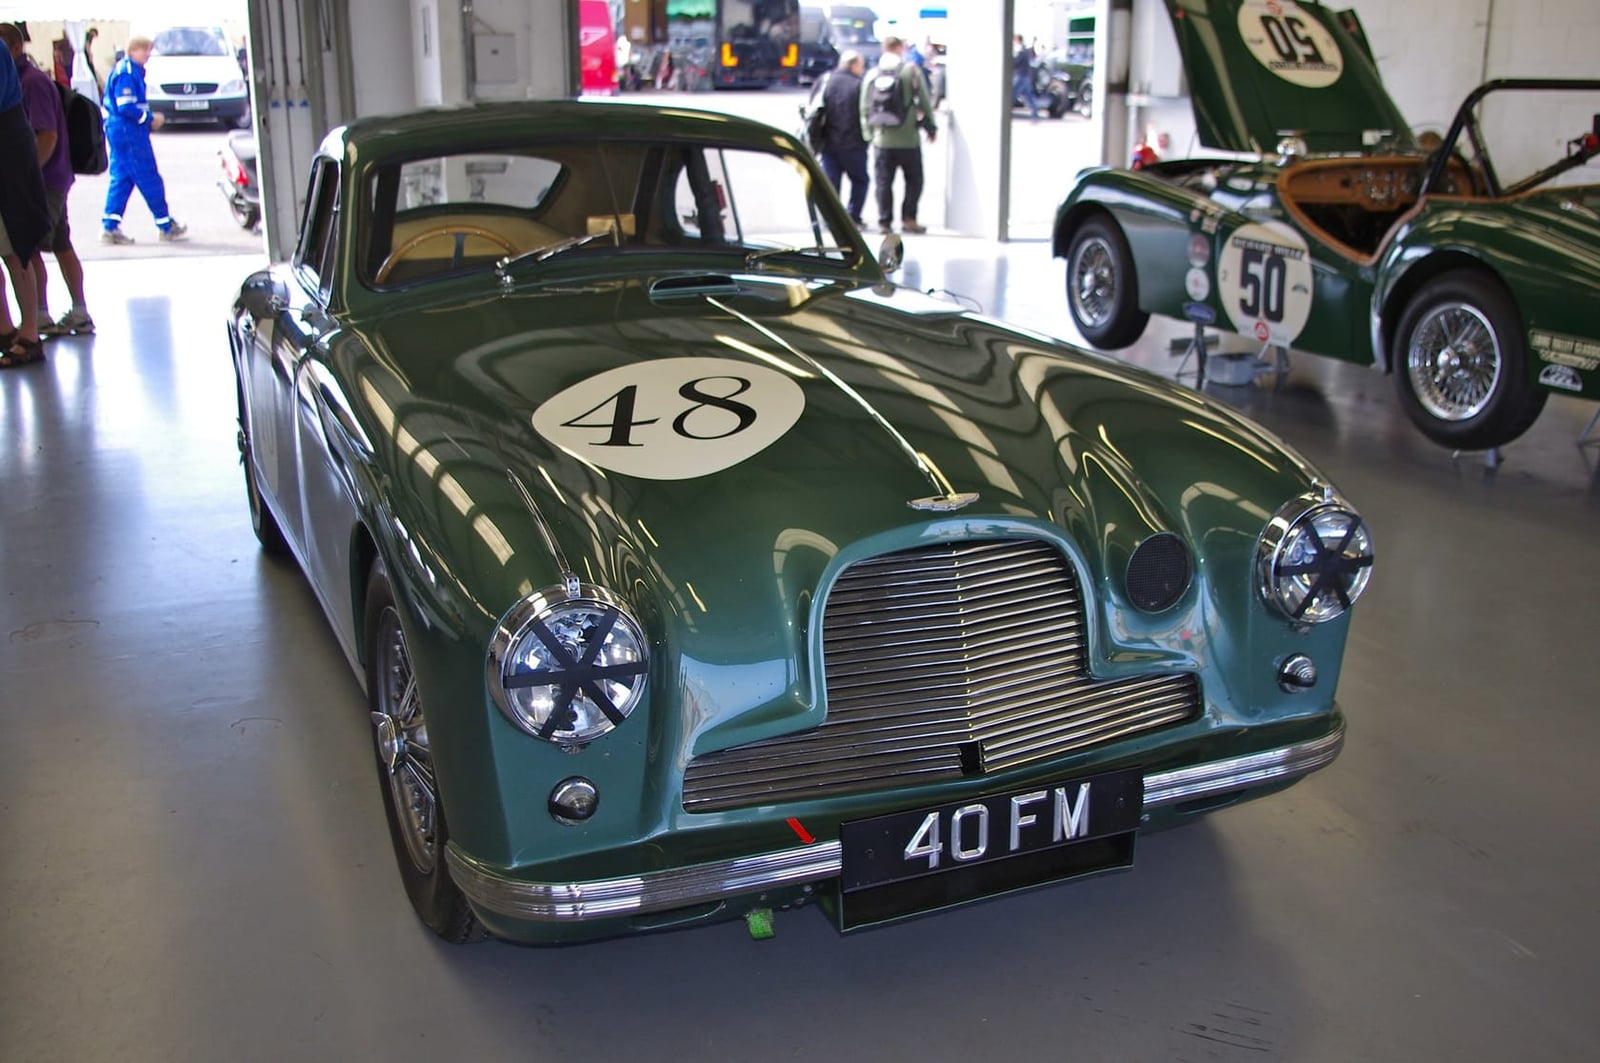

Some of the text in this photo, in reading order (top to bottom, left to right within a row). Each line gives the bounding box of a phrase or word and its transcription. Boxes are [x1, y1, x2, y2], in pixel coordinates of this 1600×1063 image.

[1240, 250, 1286, 323] 50
[560, 376, 757, 446] 48
[904, 782, 1091, 869] 40 FM
